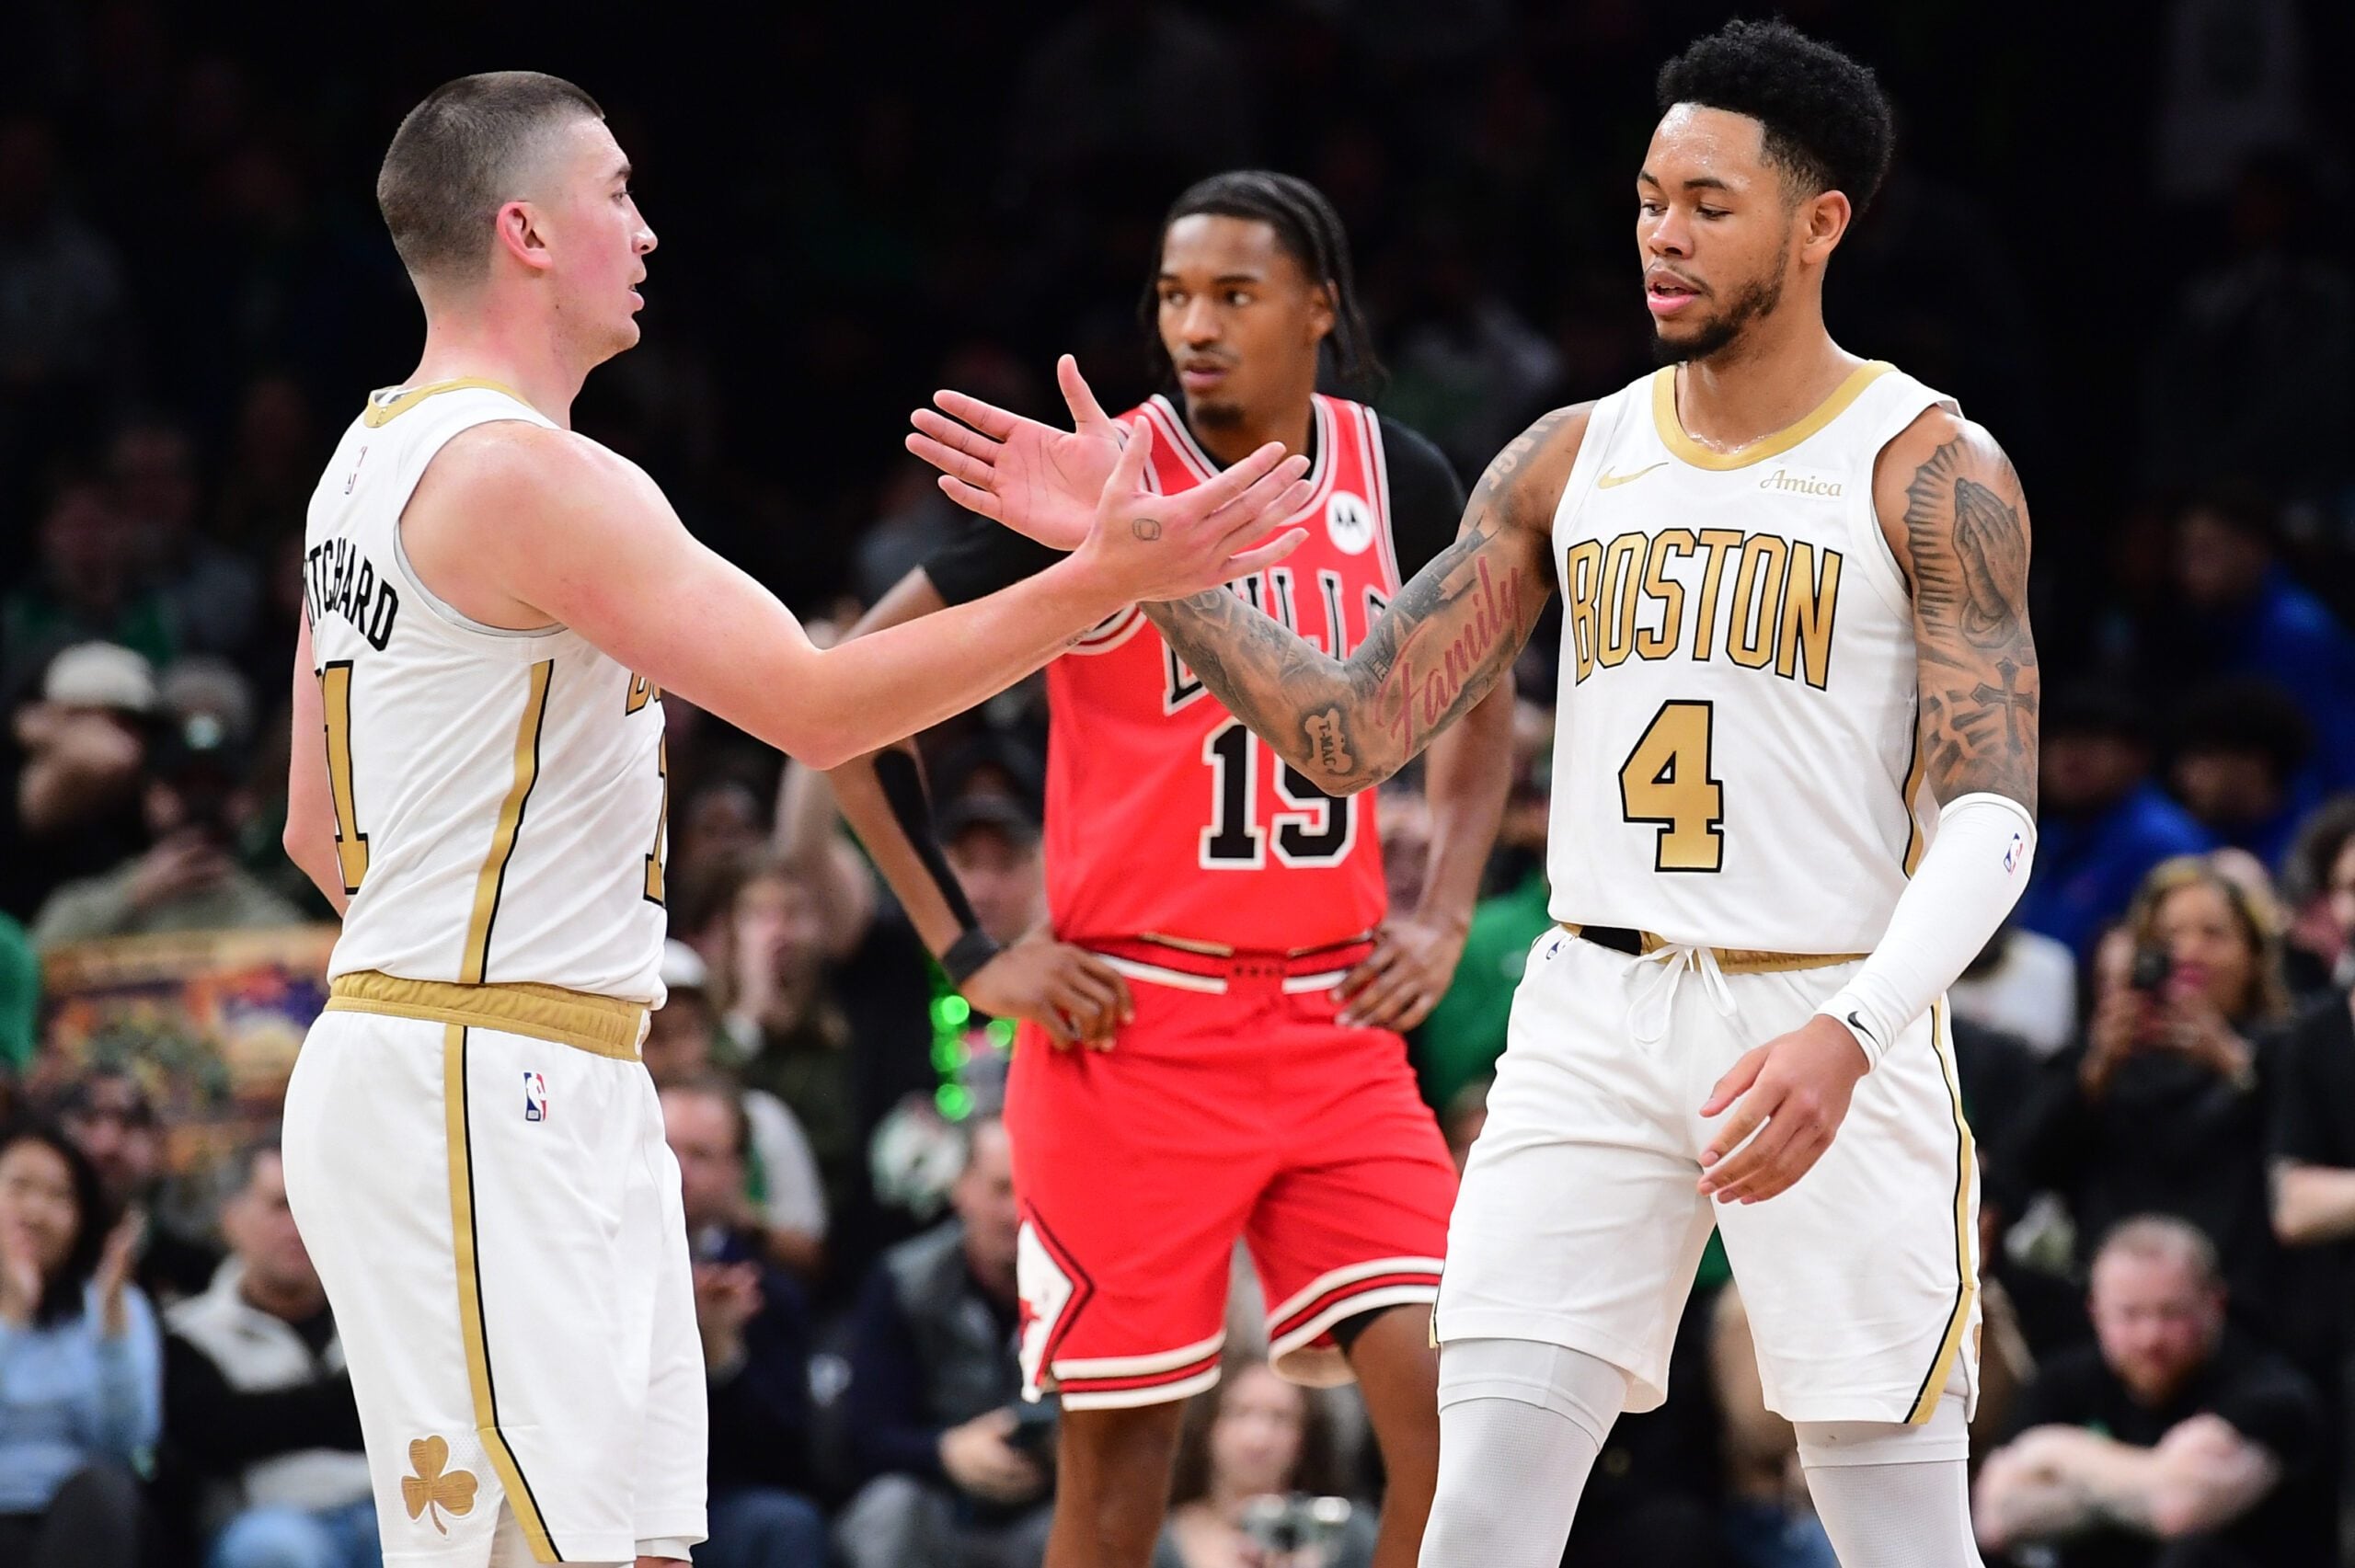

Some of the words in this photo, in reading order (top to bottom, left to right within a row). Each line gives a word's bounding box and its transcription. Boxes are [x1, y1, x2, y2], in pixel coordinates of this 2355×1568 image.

[1760, 469, 1843, 497] Amica
[1375, 556, 1524, 759] Family
[1568, 528, 1844, 692] BOSTON
[1318, 720, 1338, 766] T-MAC
[1618, 700, 1724, 873] 4
